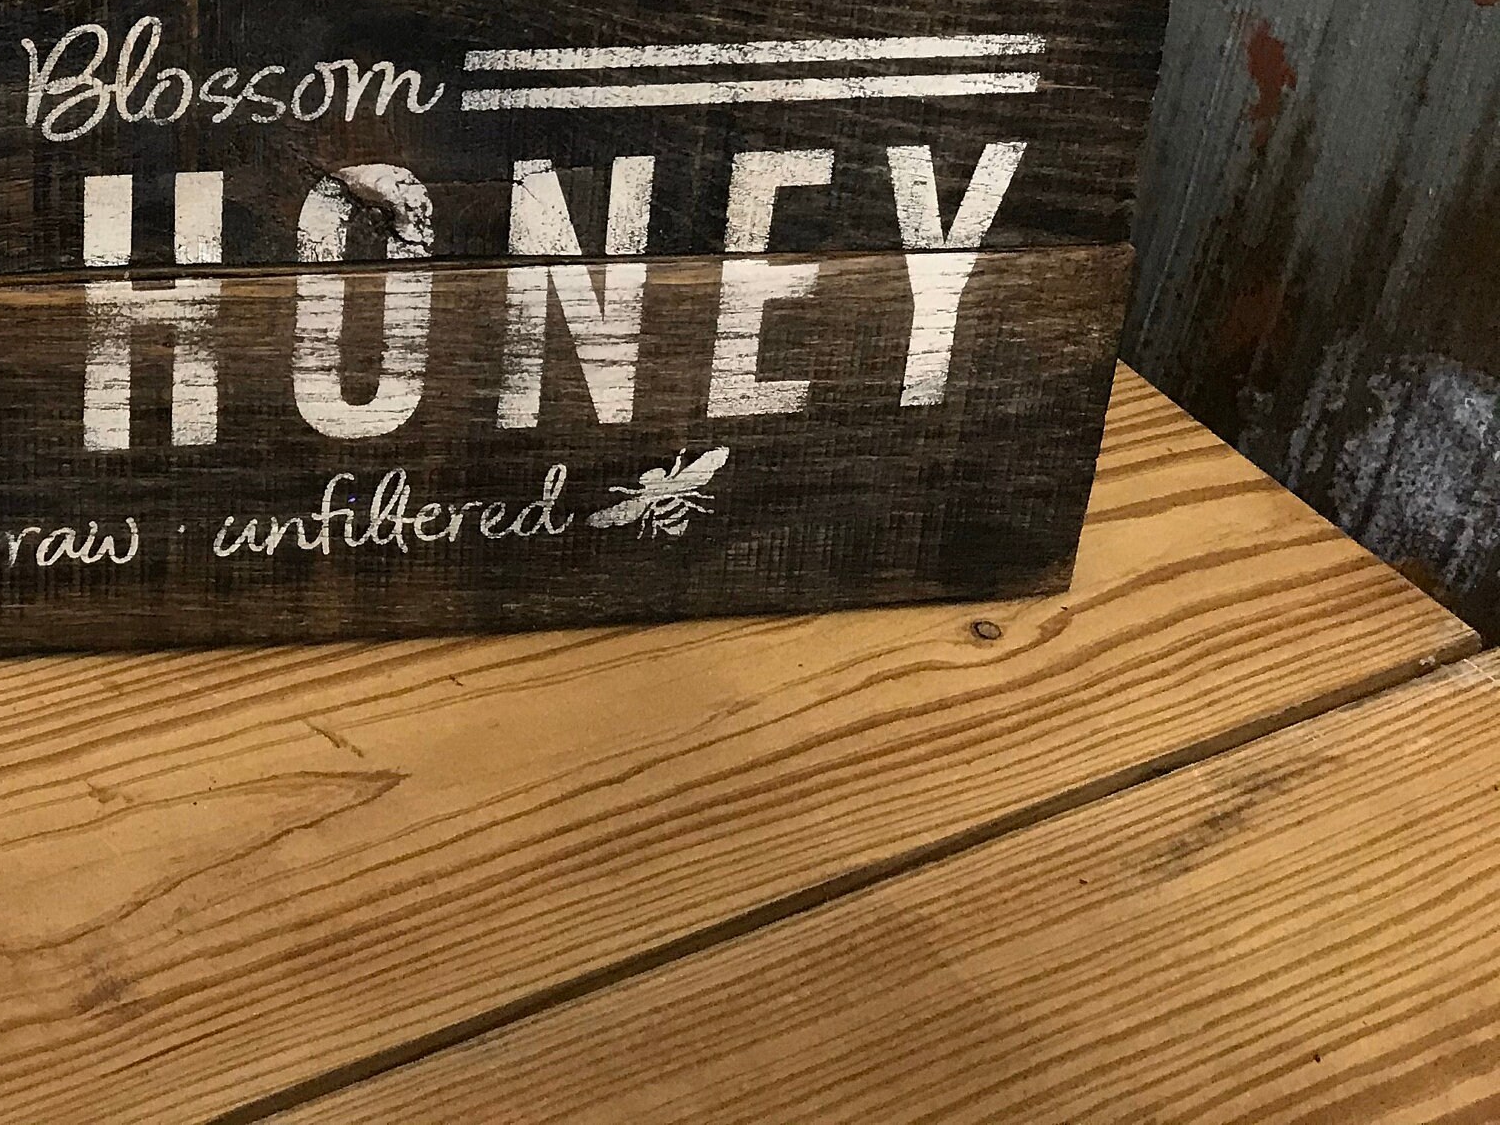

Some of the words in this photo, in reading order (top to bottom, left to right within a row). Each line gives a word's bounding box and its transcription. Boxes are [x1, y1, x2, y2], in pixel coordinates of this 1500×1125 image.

[21, 14, 446, 144] Blossom
[82, 140, 1028, 452] HONEY
[5, 515, 144, 570] raw
[211, 463, 574, 558] unfiltered
